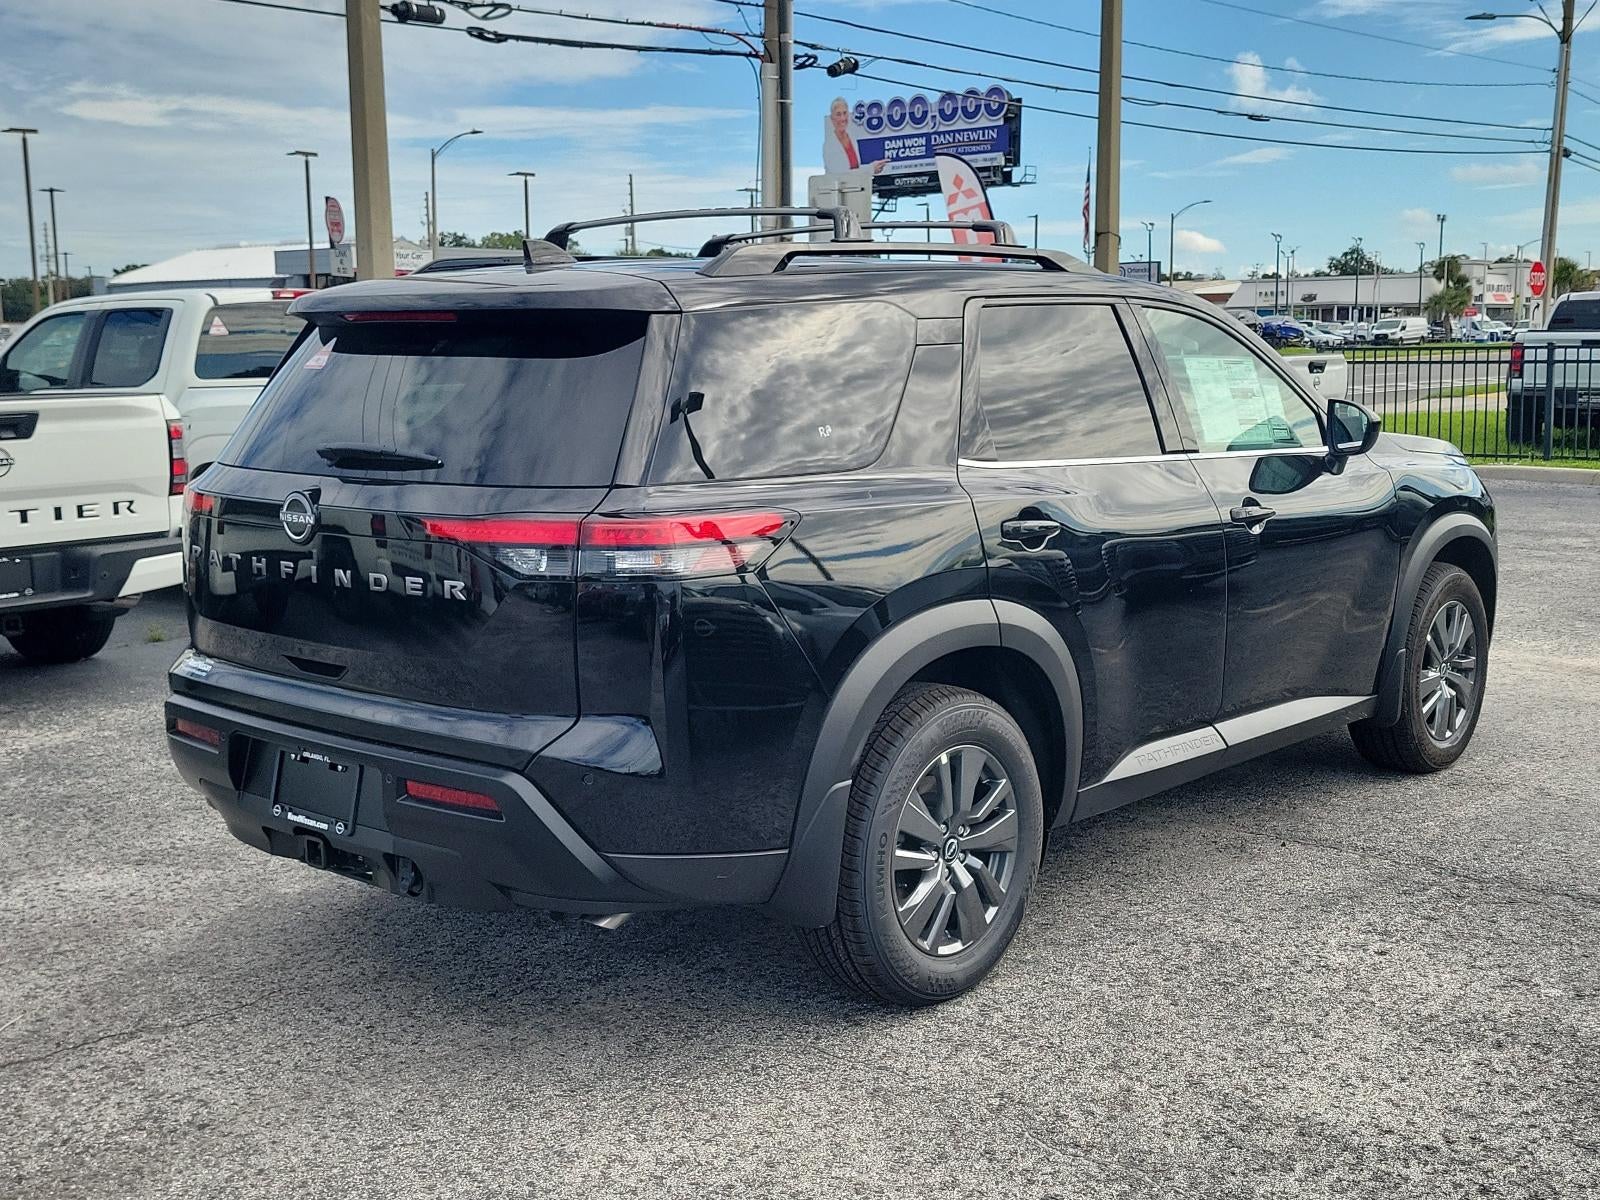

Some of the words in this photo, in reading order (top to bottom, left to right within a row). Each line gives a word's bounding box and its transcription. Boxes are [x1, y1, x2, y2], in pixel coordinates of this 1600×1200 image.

[853, 85, 1008, 132] $800,000
[884, 139, 904, 150] DAN
[904, 136, 926, 148] WON
[931, 132, 954, 145] DAN
[954, 128, 998, 143] NEWLIN
[884, 148, 898, 159] MY
[1530, 271, 1546, 287] STOP
[8, 500, 137, 526] TIER
[280, 512, 314, 525] NISSAN
[190, 544, 468, 601] PATHFINDER
[1134, 733, 1221, 767] PATHFINDER
